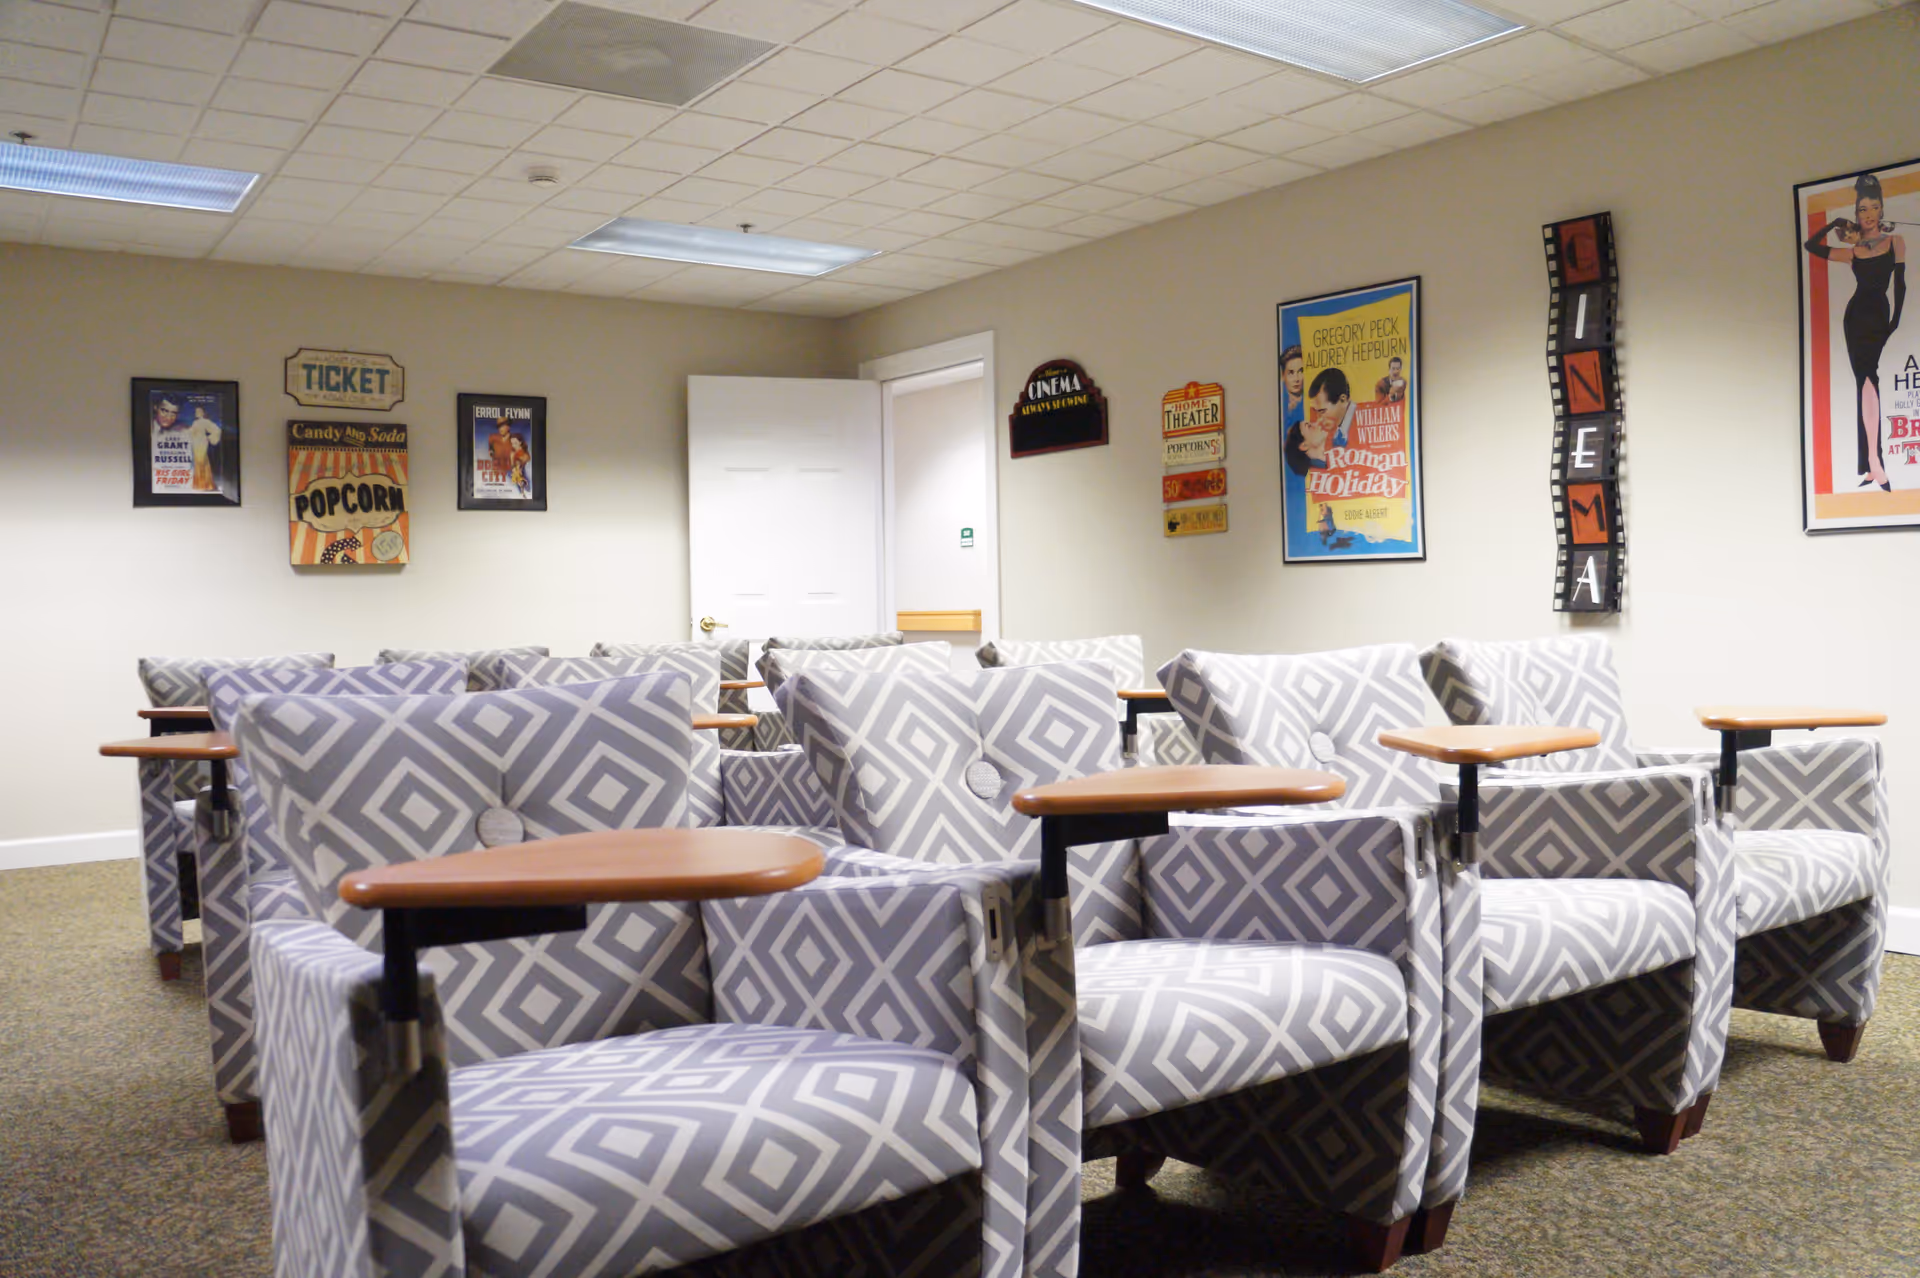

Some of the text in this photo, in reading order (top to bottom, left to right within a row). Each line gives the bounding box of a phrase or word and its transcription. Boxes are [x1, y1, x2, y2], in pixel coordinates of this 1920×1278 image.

[1313, 316, 1399, 348] GREGORY PECK
[1306, 337, 1407, 369] AUDREY HEPBURN
[302, 363, 390, 394] TICKET
[1028, 373, 1080, 400] CINEMA
[475, 406, 531, 420] ERROL FLYNN
[1895, 400, 1914, 409] HOLLY
[1165, 403, 1218, 430] THEATER
[1355, 405, 1400, 426] WILLIAM
[292, 423, 341, 442] Candy
[368, 427, 406, 443] Soda
[157, 441, 189, 449] GRANT
[1167, 440, 1210, 454] POPCORN
[1888, 444, 1900, 455] AT
[154, 455, 192, 463] RUSSELL
[1324, 446, 1408, 472] Roman
[156, 477, 190, 485] FRIDAY
[1305, 469, 1409, 498] Holiday
[295, 483, 405, 520] POPCORN
[1344, 509, 1362, 521] EDDIE
